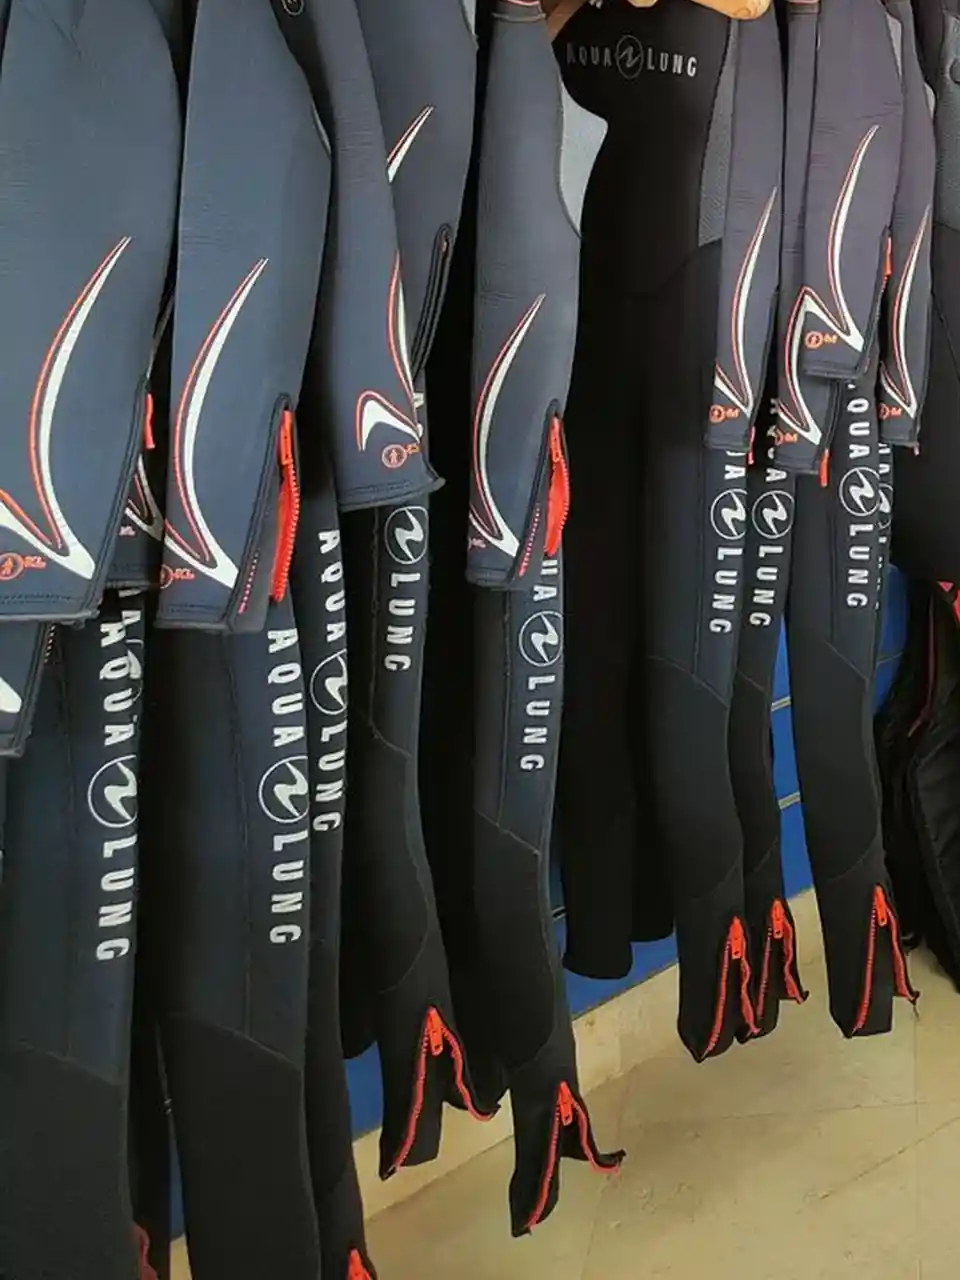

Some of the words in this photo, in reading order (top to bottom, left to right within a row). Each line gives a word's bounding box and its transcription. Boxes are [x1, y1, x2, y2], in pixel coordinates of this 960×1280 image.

[566, 42, 613, 68] AQUA
[646, 47, 697, 78] LUNG
[847, 384, 871, 460] QUA
[318, 529, 347, 643] AQUA
[709, 546, 743, 634] LUNG
[749, 545, 784, 627] LUNG
[846, 523, 874, 608] LUNG
[384, 572, 421, 671] LUNG
[100, 621, 135, 747] AQUA
[267, 628, 304, 748] AQUA
[520, 674, 556, 771] LUNG
[312, 720, 348, 832] LUNG
[96, 833, 138, 961] LUNG
[270, 829, 309, 944] LUNG
